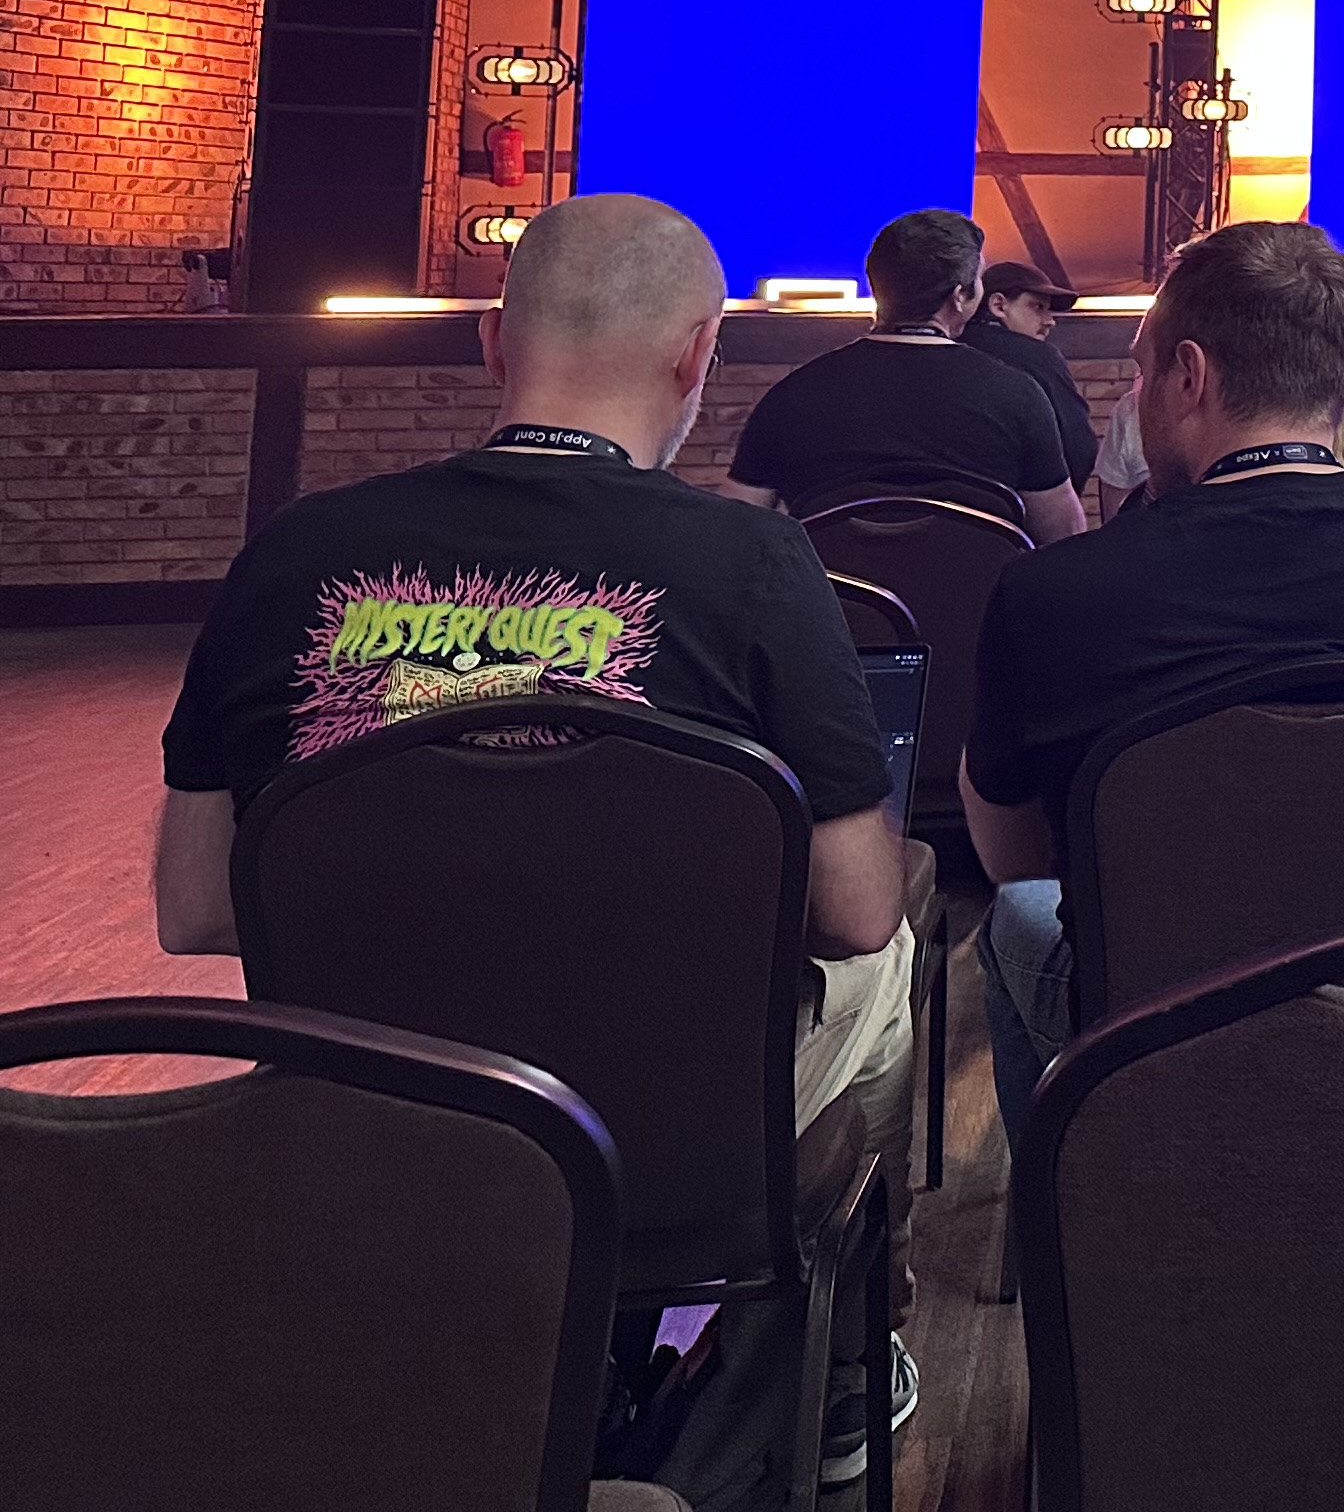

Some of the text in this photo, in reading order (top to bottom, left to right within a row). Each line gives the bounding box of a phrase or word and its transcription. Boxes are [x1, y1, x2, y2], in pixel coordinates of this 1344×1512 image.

[514, 430, 592, 448] App.js Conf
[329, 597, 624, 681] MYSTERY QUEST
